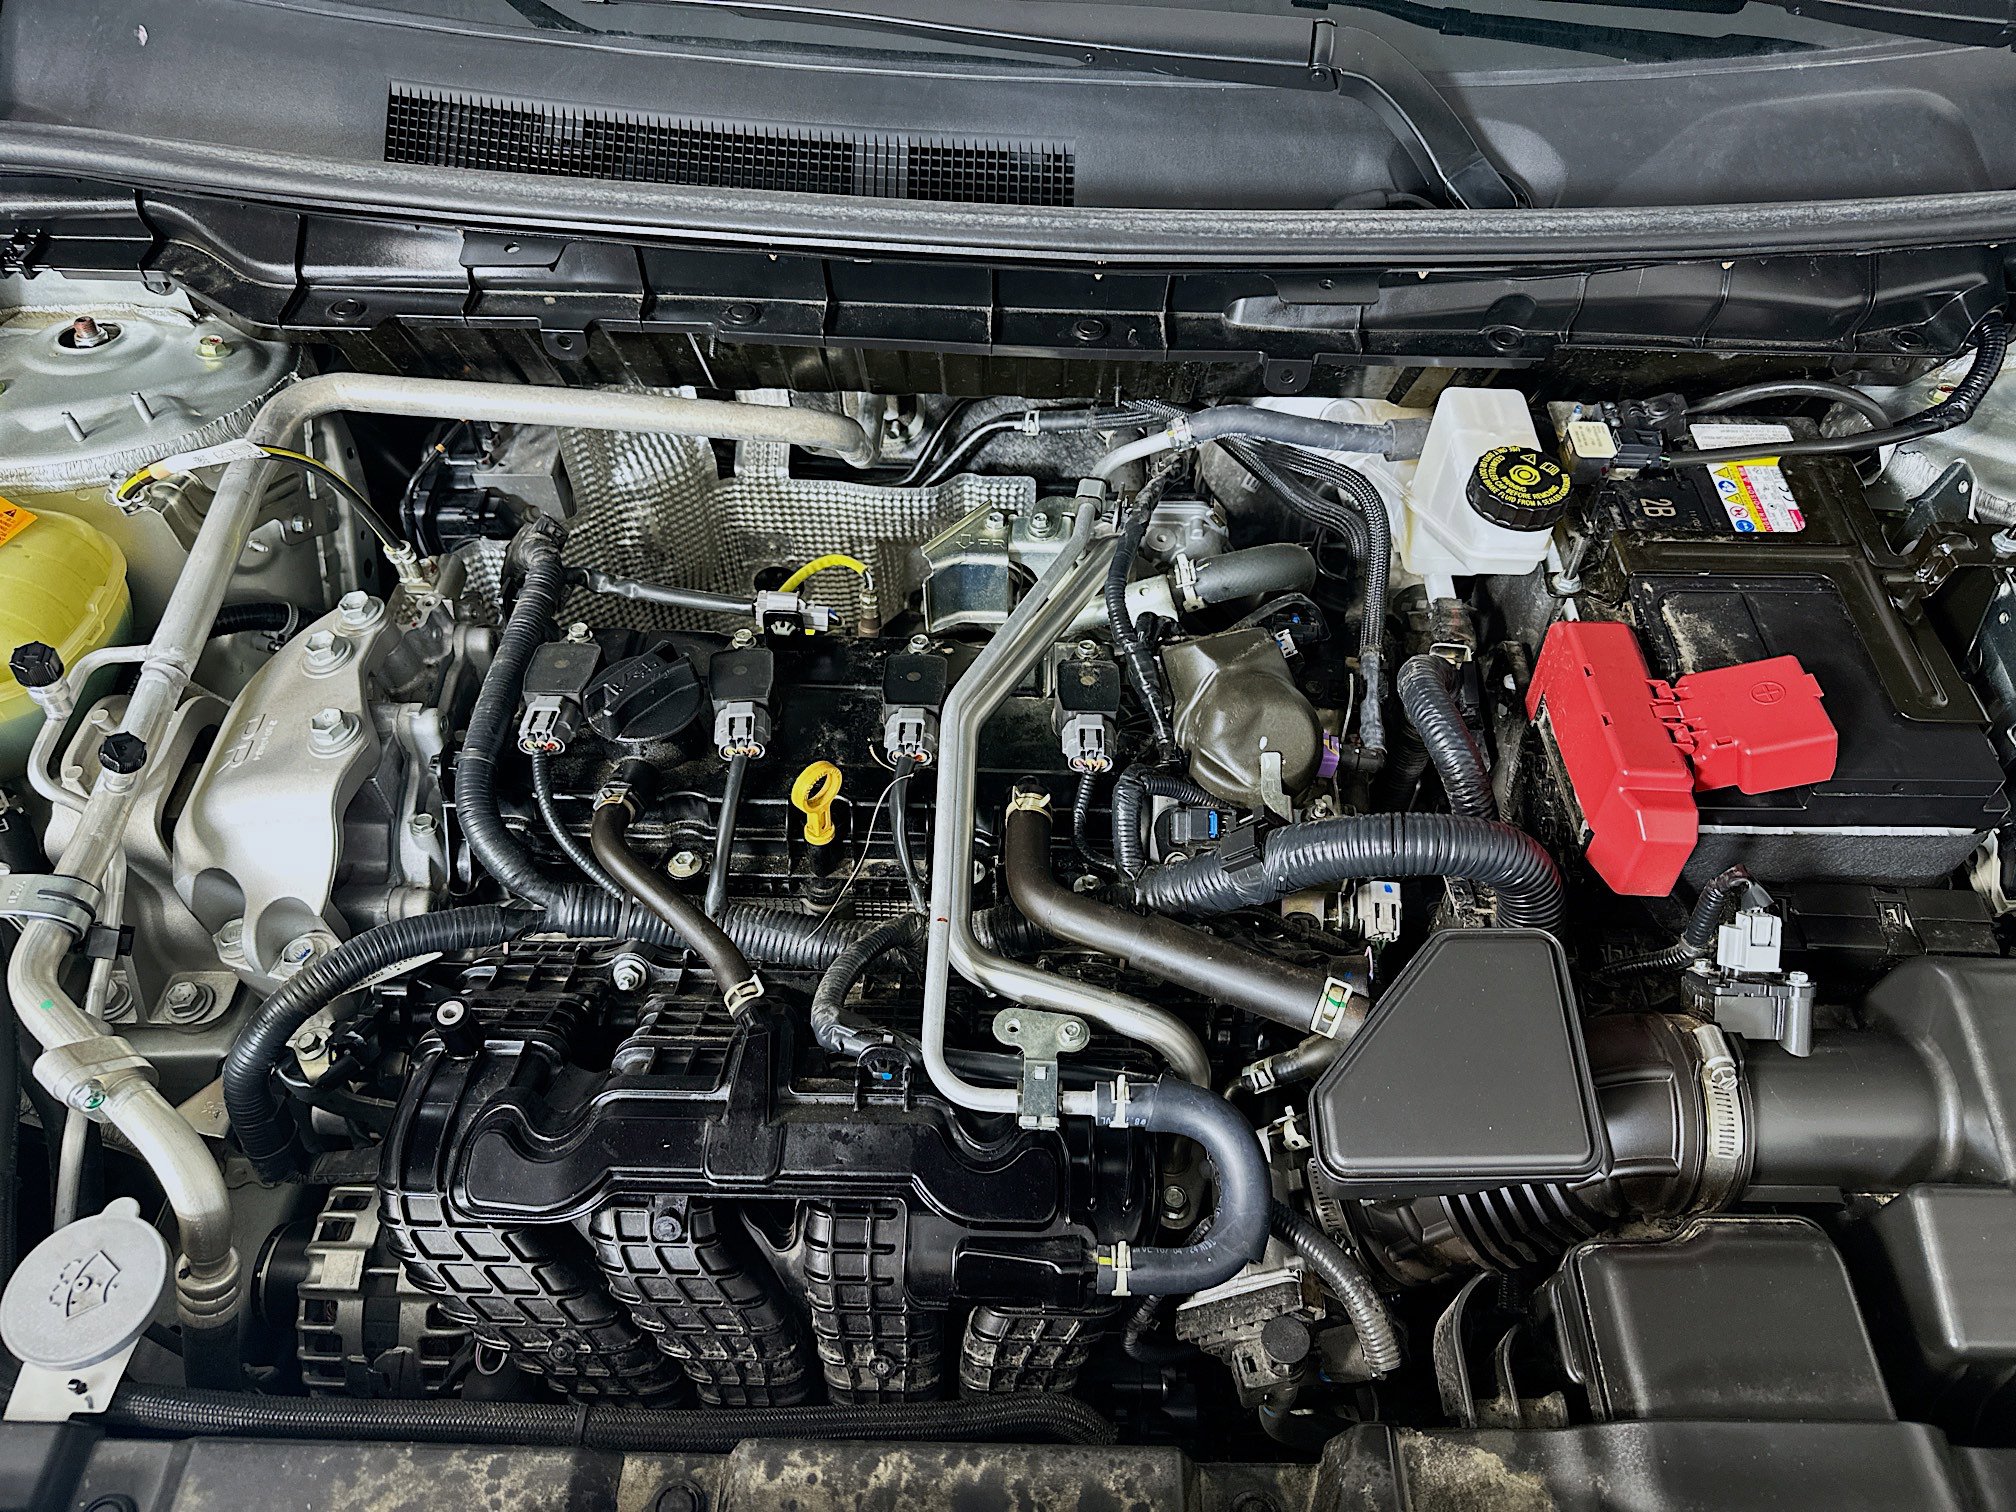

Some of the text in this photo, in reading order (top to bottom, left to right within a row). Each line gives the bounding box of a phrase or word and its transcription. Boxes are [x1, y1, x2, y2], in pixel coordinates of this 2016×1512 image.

[1495, 480, 1507, 489] CAP
[1505, 488, 1532, 499] BEFORE
[1498, 491, 1516, 503] FLUID
[1640, 498, 1677, 517] 2B
[978, 538, 1005, 550] FR
